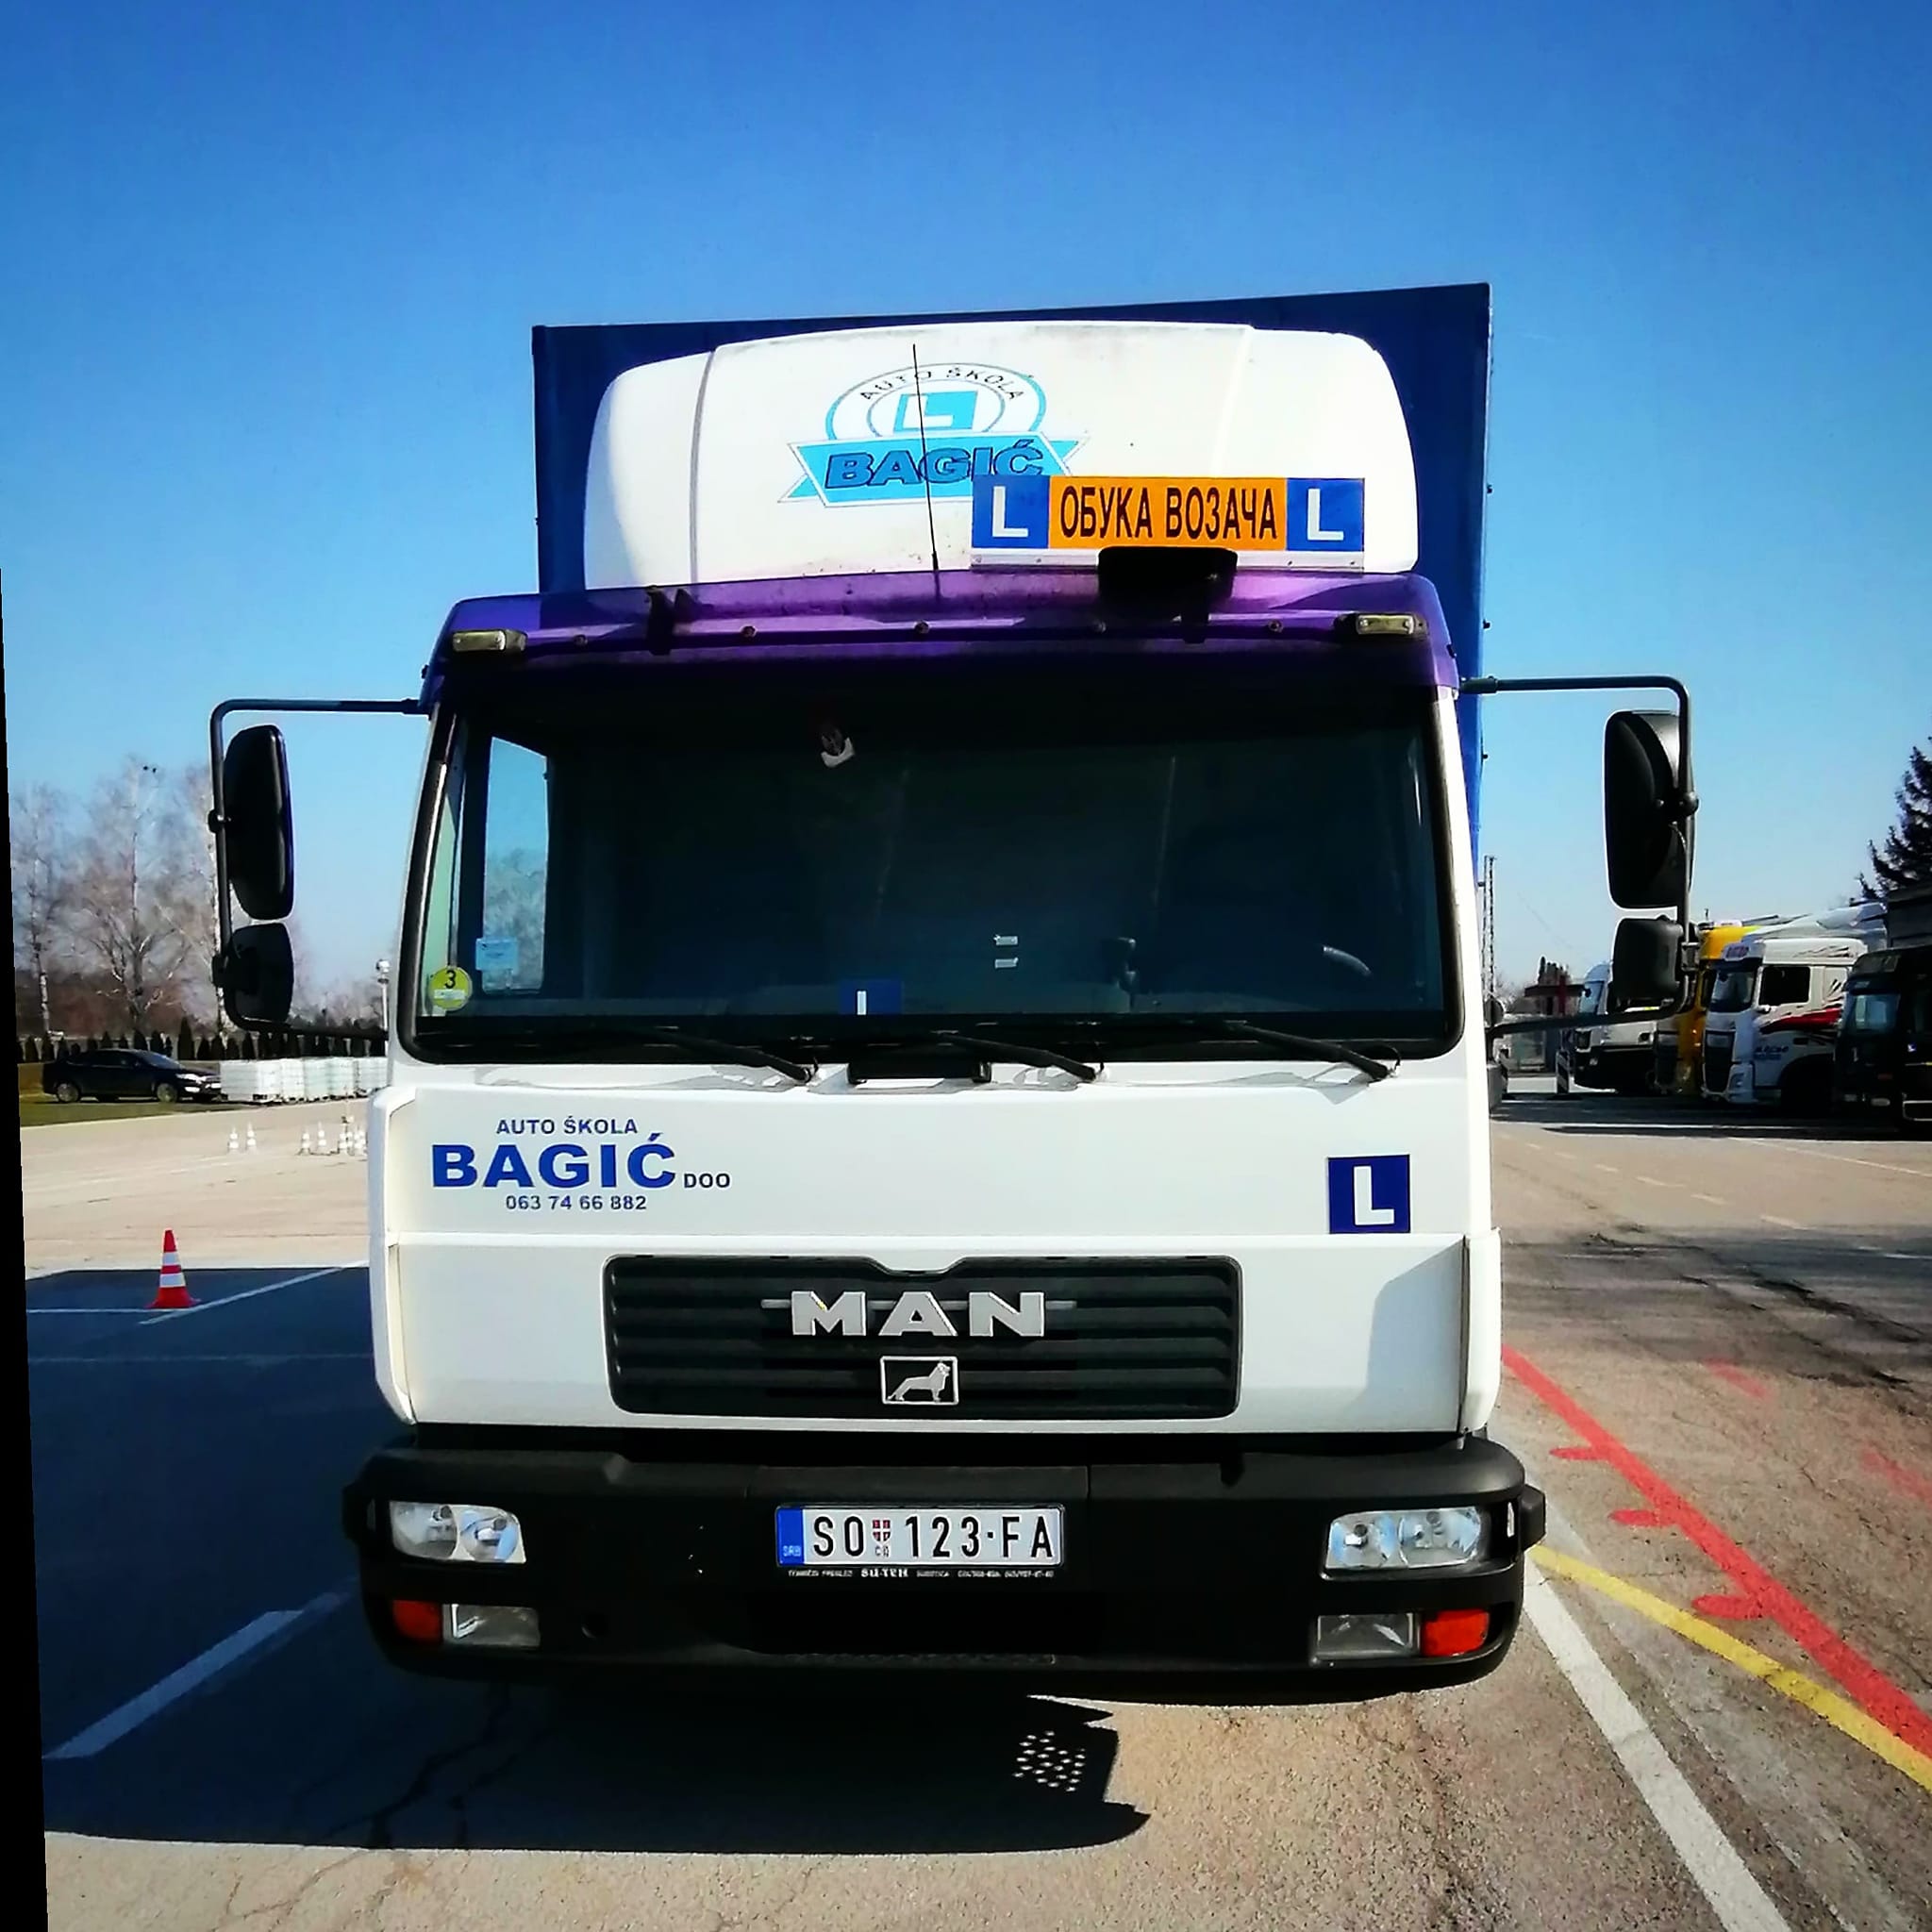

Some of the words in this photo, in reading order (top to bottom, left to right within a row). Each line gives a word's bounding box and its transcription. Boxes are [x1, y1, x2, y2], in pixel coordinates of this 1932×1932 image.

[824, 439, 1043, 489] BAGIĆ
[991, 485, 1029, 538] L
[1060, 485, 1153, 538] ОБУКА
[1165, 486, 1277, 540] ВОЗАЧА
[1307, 488, 1344, 541] L
[444, 969, 458, 990] 3
[496, 1119, 556, 1135] AUTO
[431, 1132, 676, 1189] BAGIĆ
[683, 1173, 731, 1189] DOO
[506, 1194, 541, 1210] 063
[547, 1194, 573, 1210] 74
[578, 1194, 604, 1210] 66
[609, 1194, 648, 1210] 882
[1353, 1165, 1395, 1226] L
[791, 1291, 1044, 1337] MAN
[812, 1515, 865, 1557] SO
